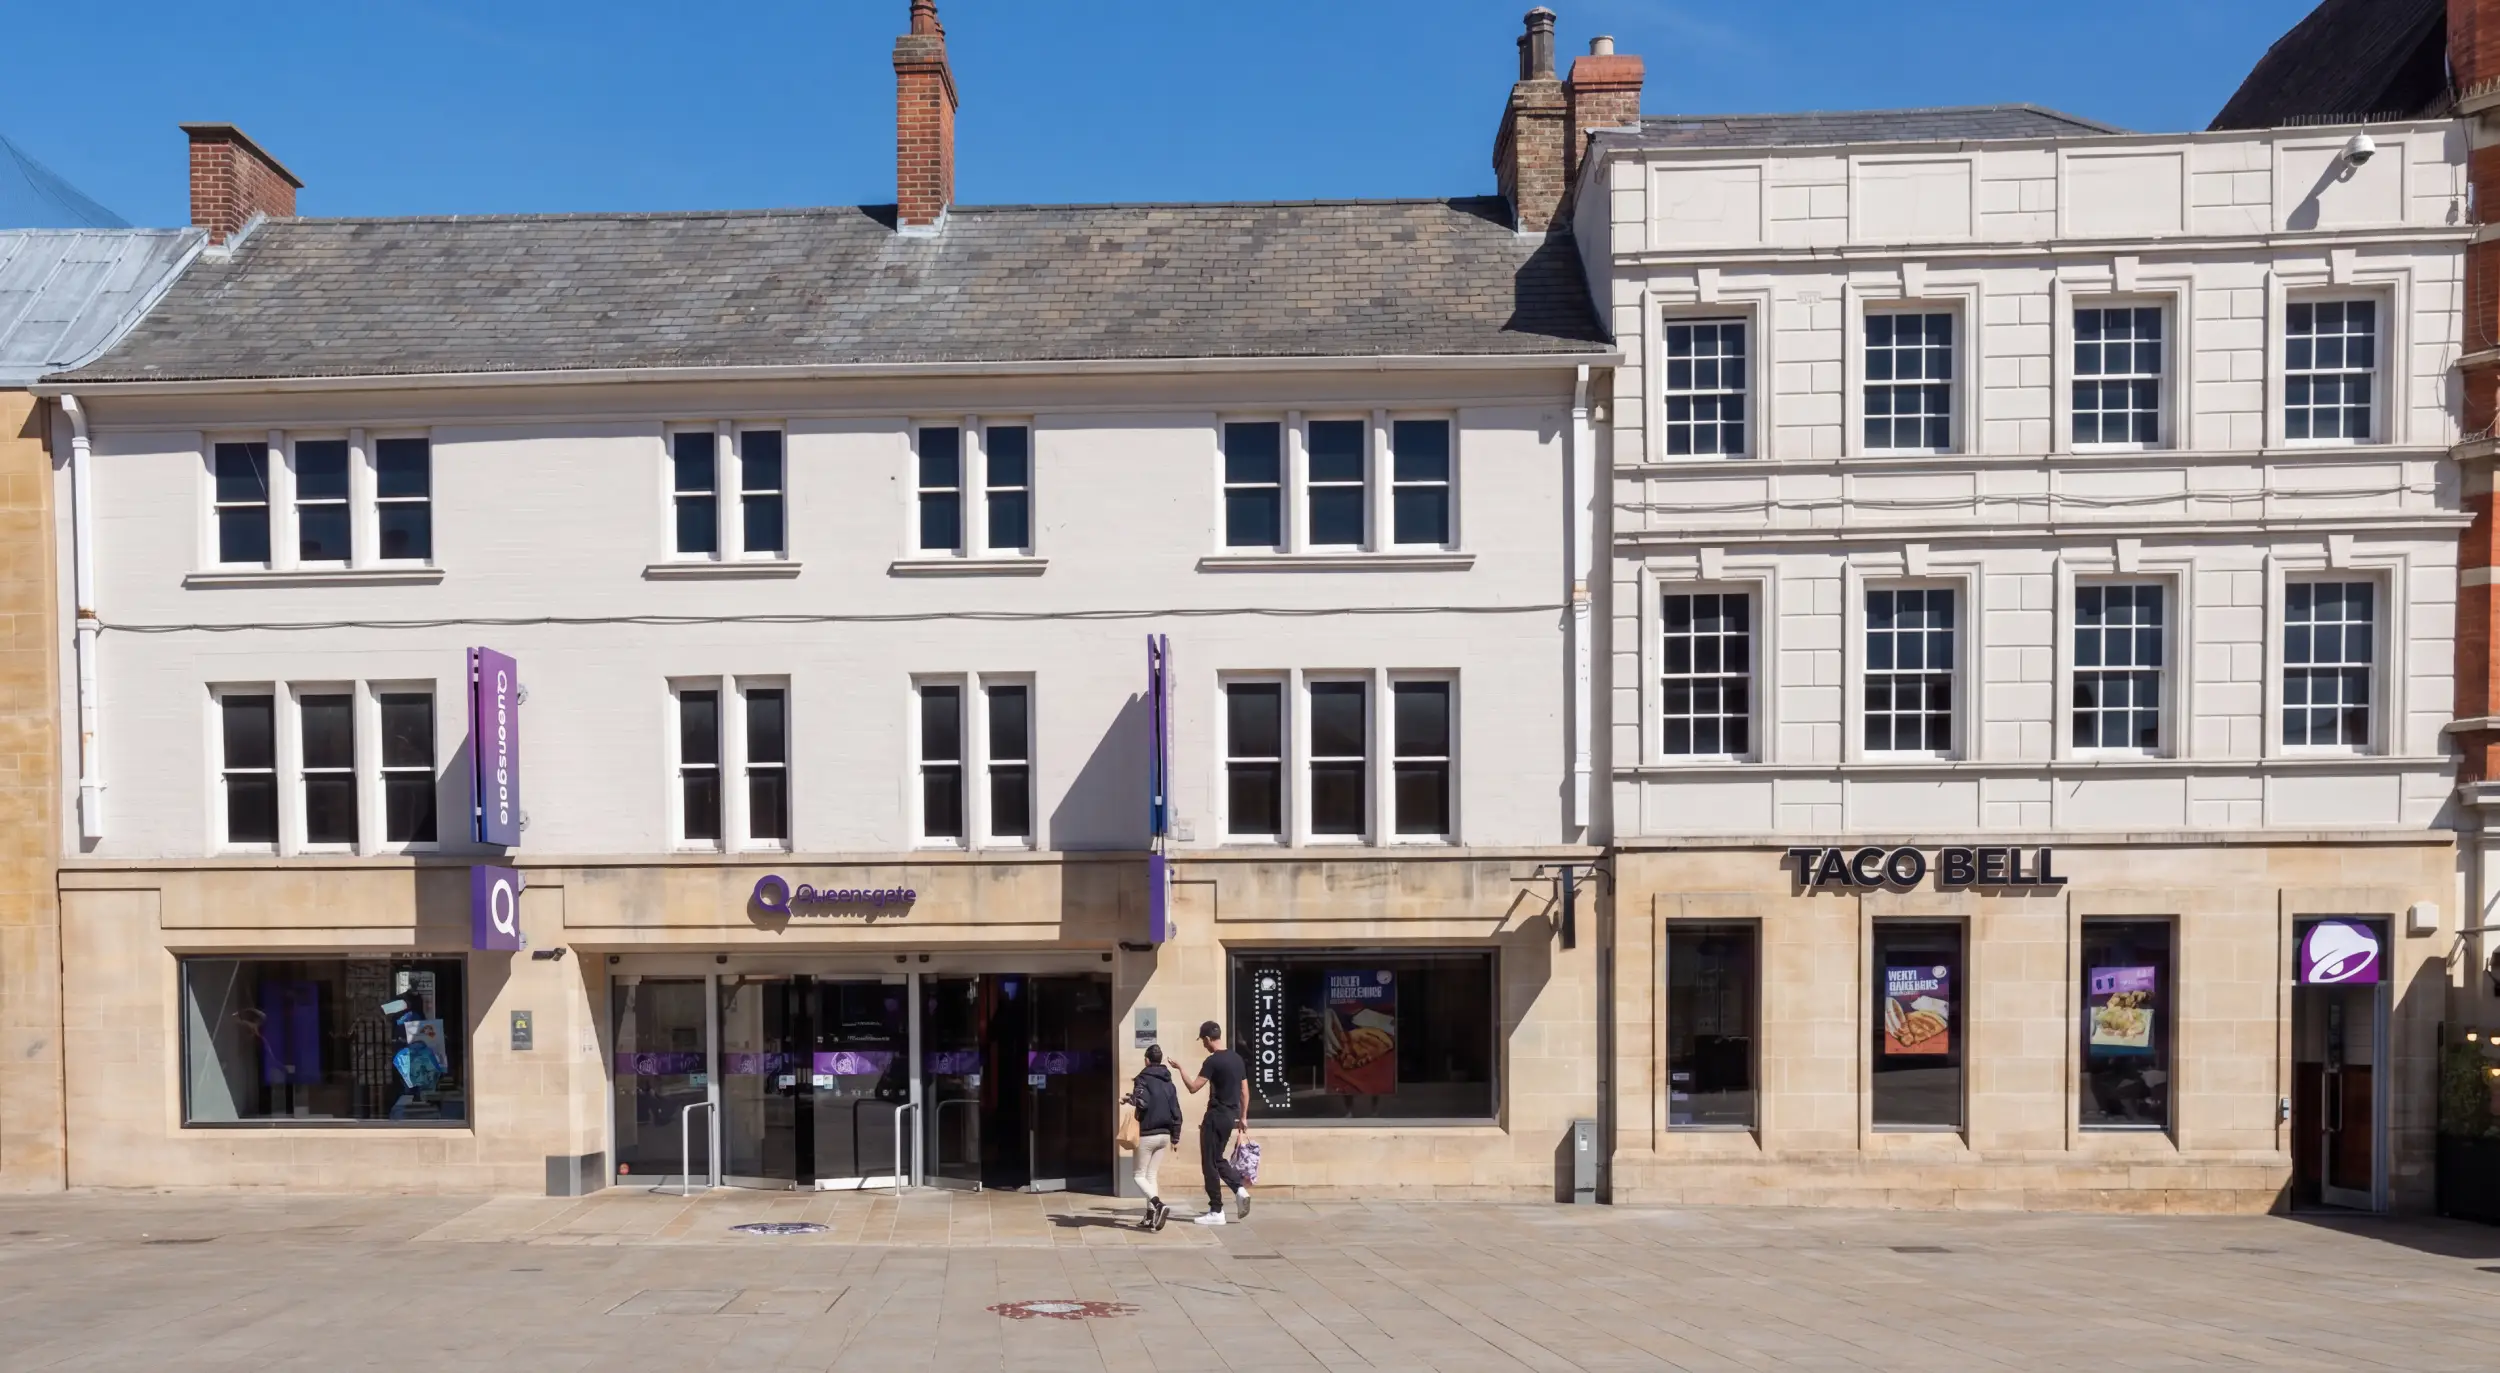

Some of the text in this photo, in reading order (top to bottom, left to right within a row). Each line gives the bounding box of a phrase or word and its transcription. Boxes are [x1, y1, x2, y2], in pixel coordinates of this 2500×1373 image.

[1788, 846, 2068, 886] TACO BELL
[491, 878, 516, 937] Q
[796, 883, 917, 907] Queensgate
